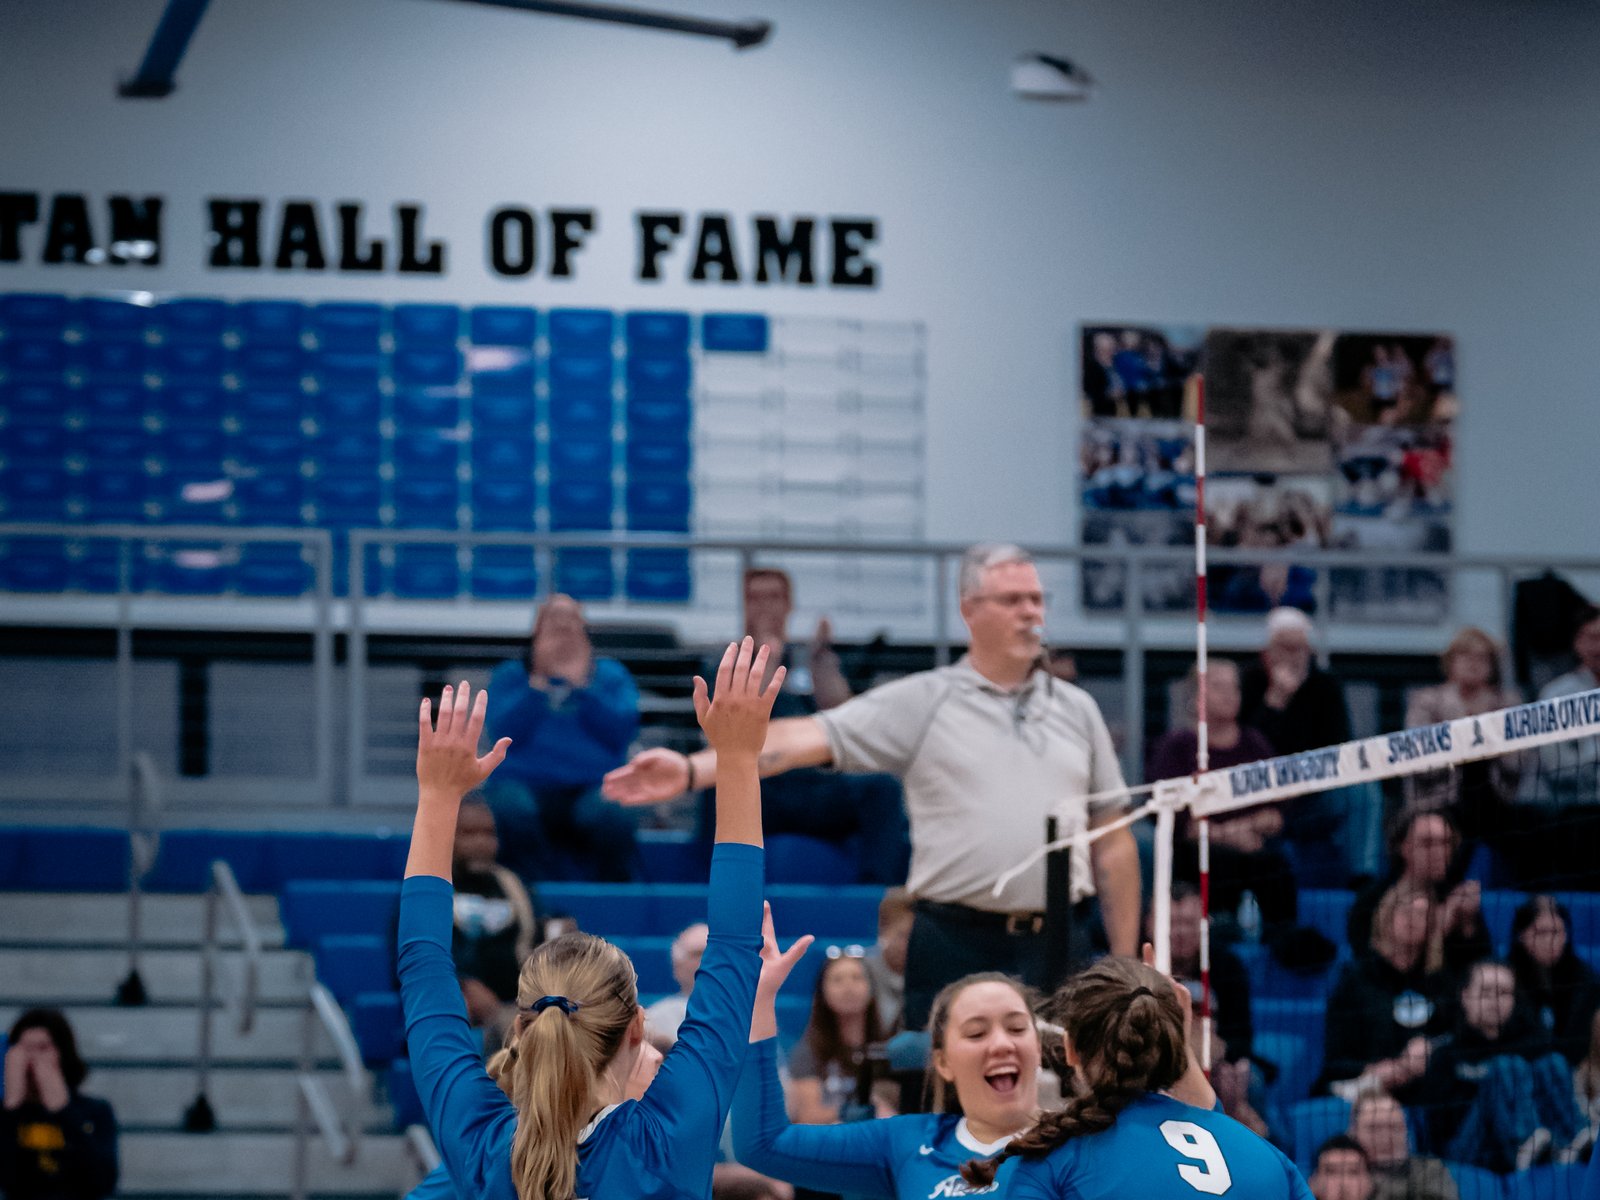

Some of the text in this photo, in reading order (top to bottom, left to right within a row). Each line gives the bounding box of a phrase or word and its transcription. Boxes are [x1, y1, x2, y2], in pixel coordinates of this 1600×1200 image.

[0, 191, 877, 286] TAN HALL OF FAME
[1159, 1120, 1232, 1195] 9
